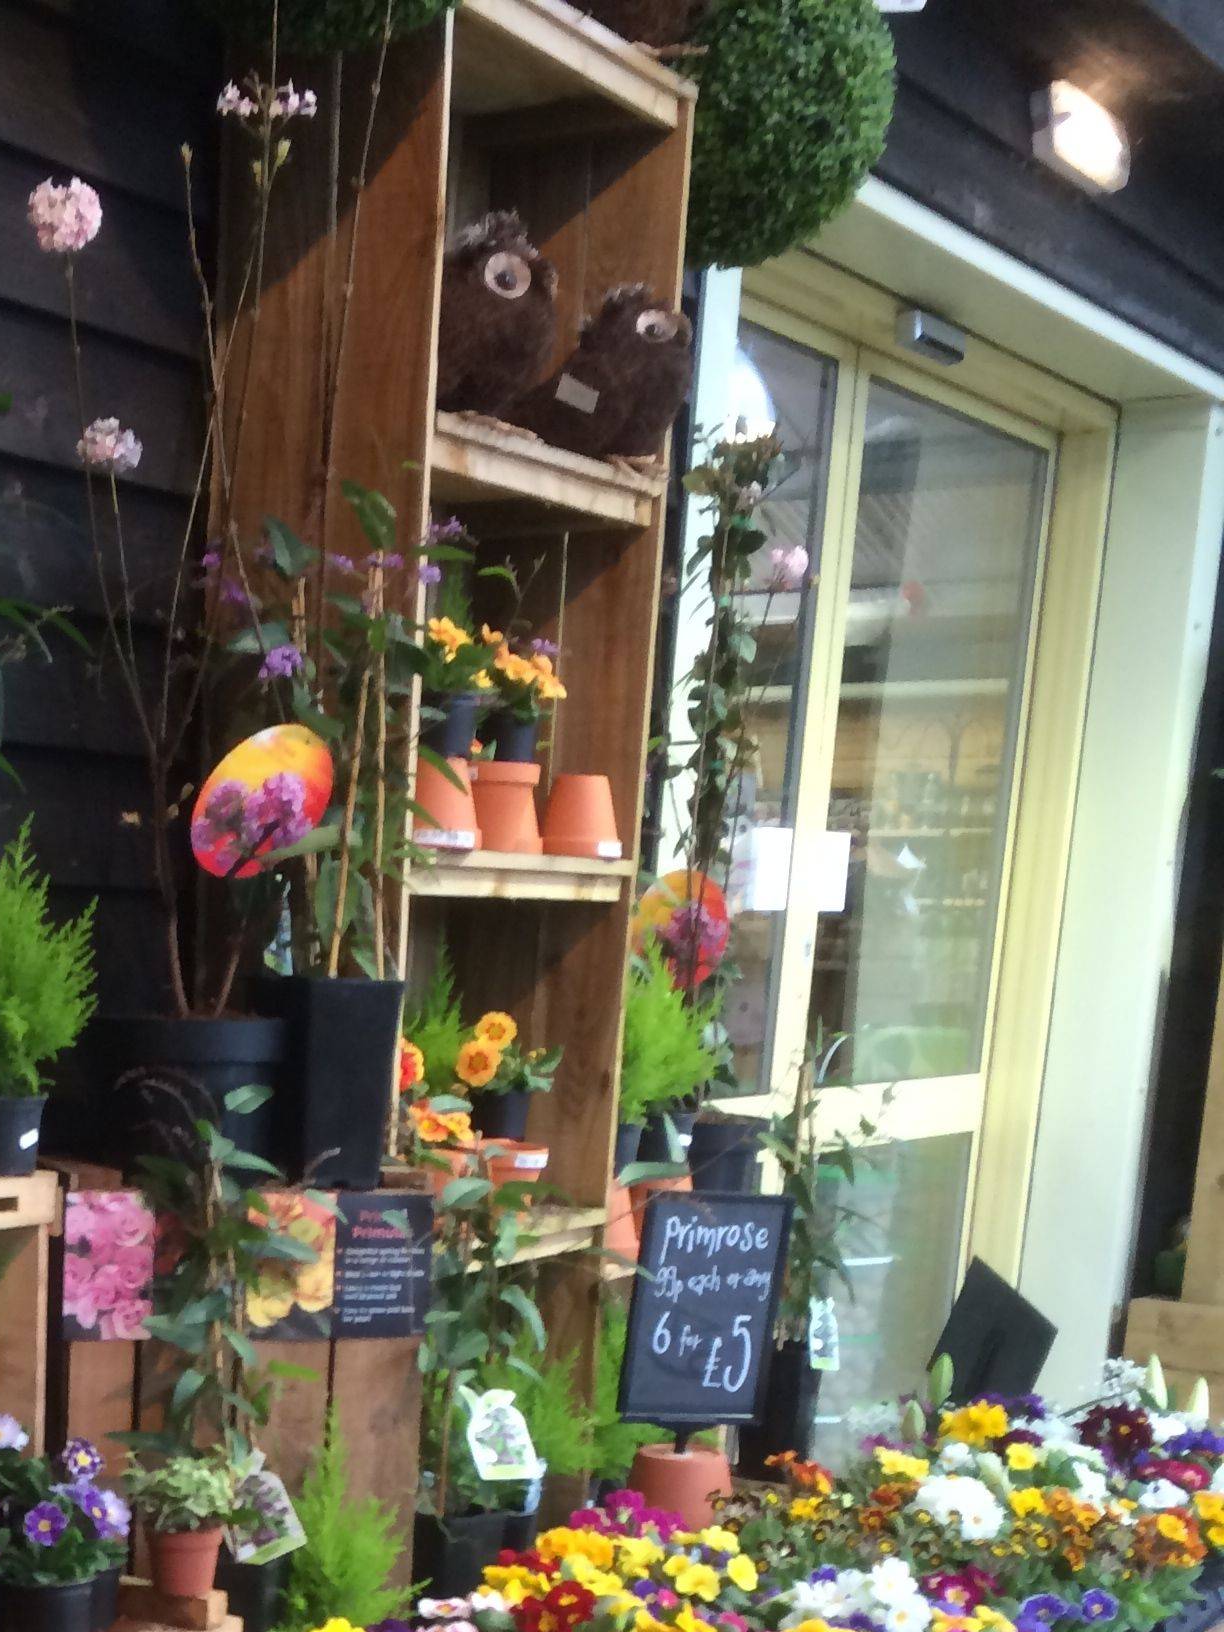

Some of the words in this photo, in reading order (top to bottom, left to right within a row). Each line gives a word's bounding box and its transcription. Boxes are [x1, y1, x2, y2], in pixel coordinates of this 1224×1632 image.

[688, 1264, 720, 1296] each
[652, 1311, 672, 1355] 6
[680, 1324, 704, 1357] for
[702, 1314, 752, 1393] £5
